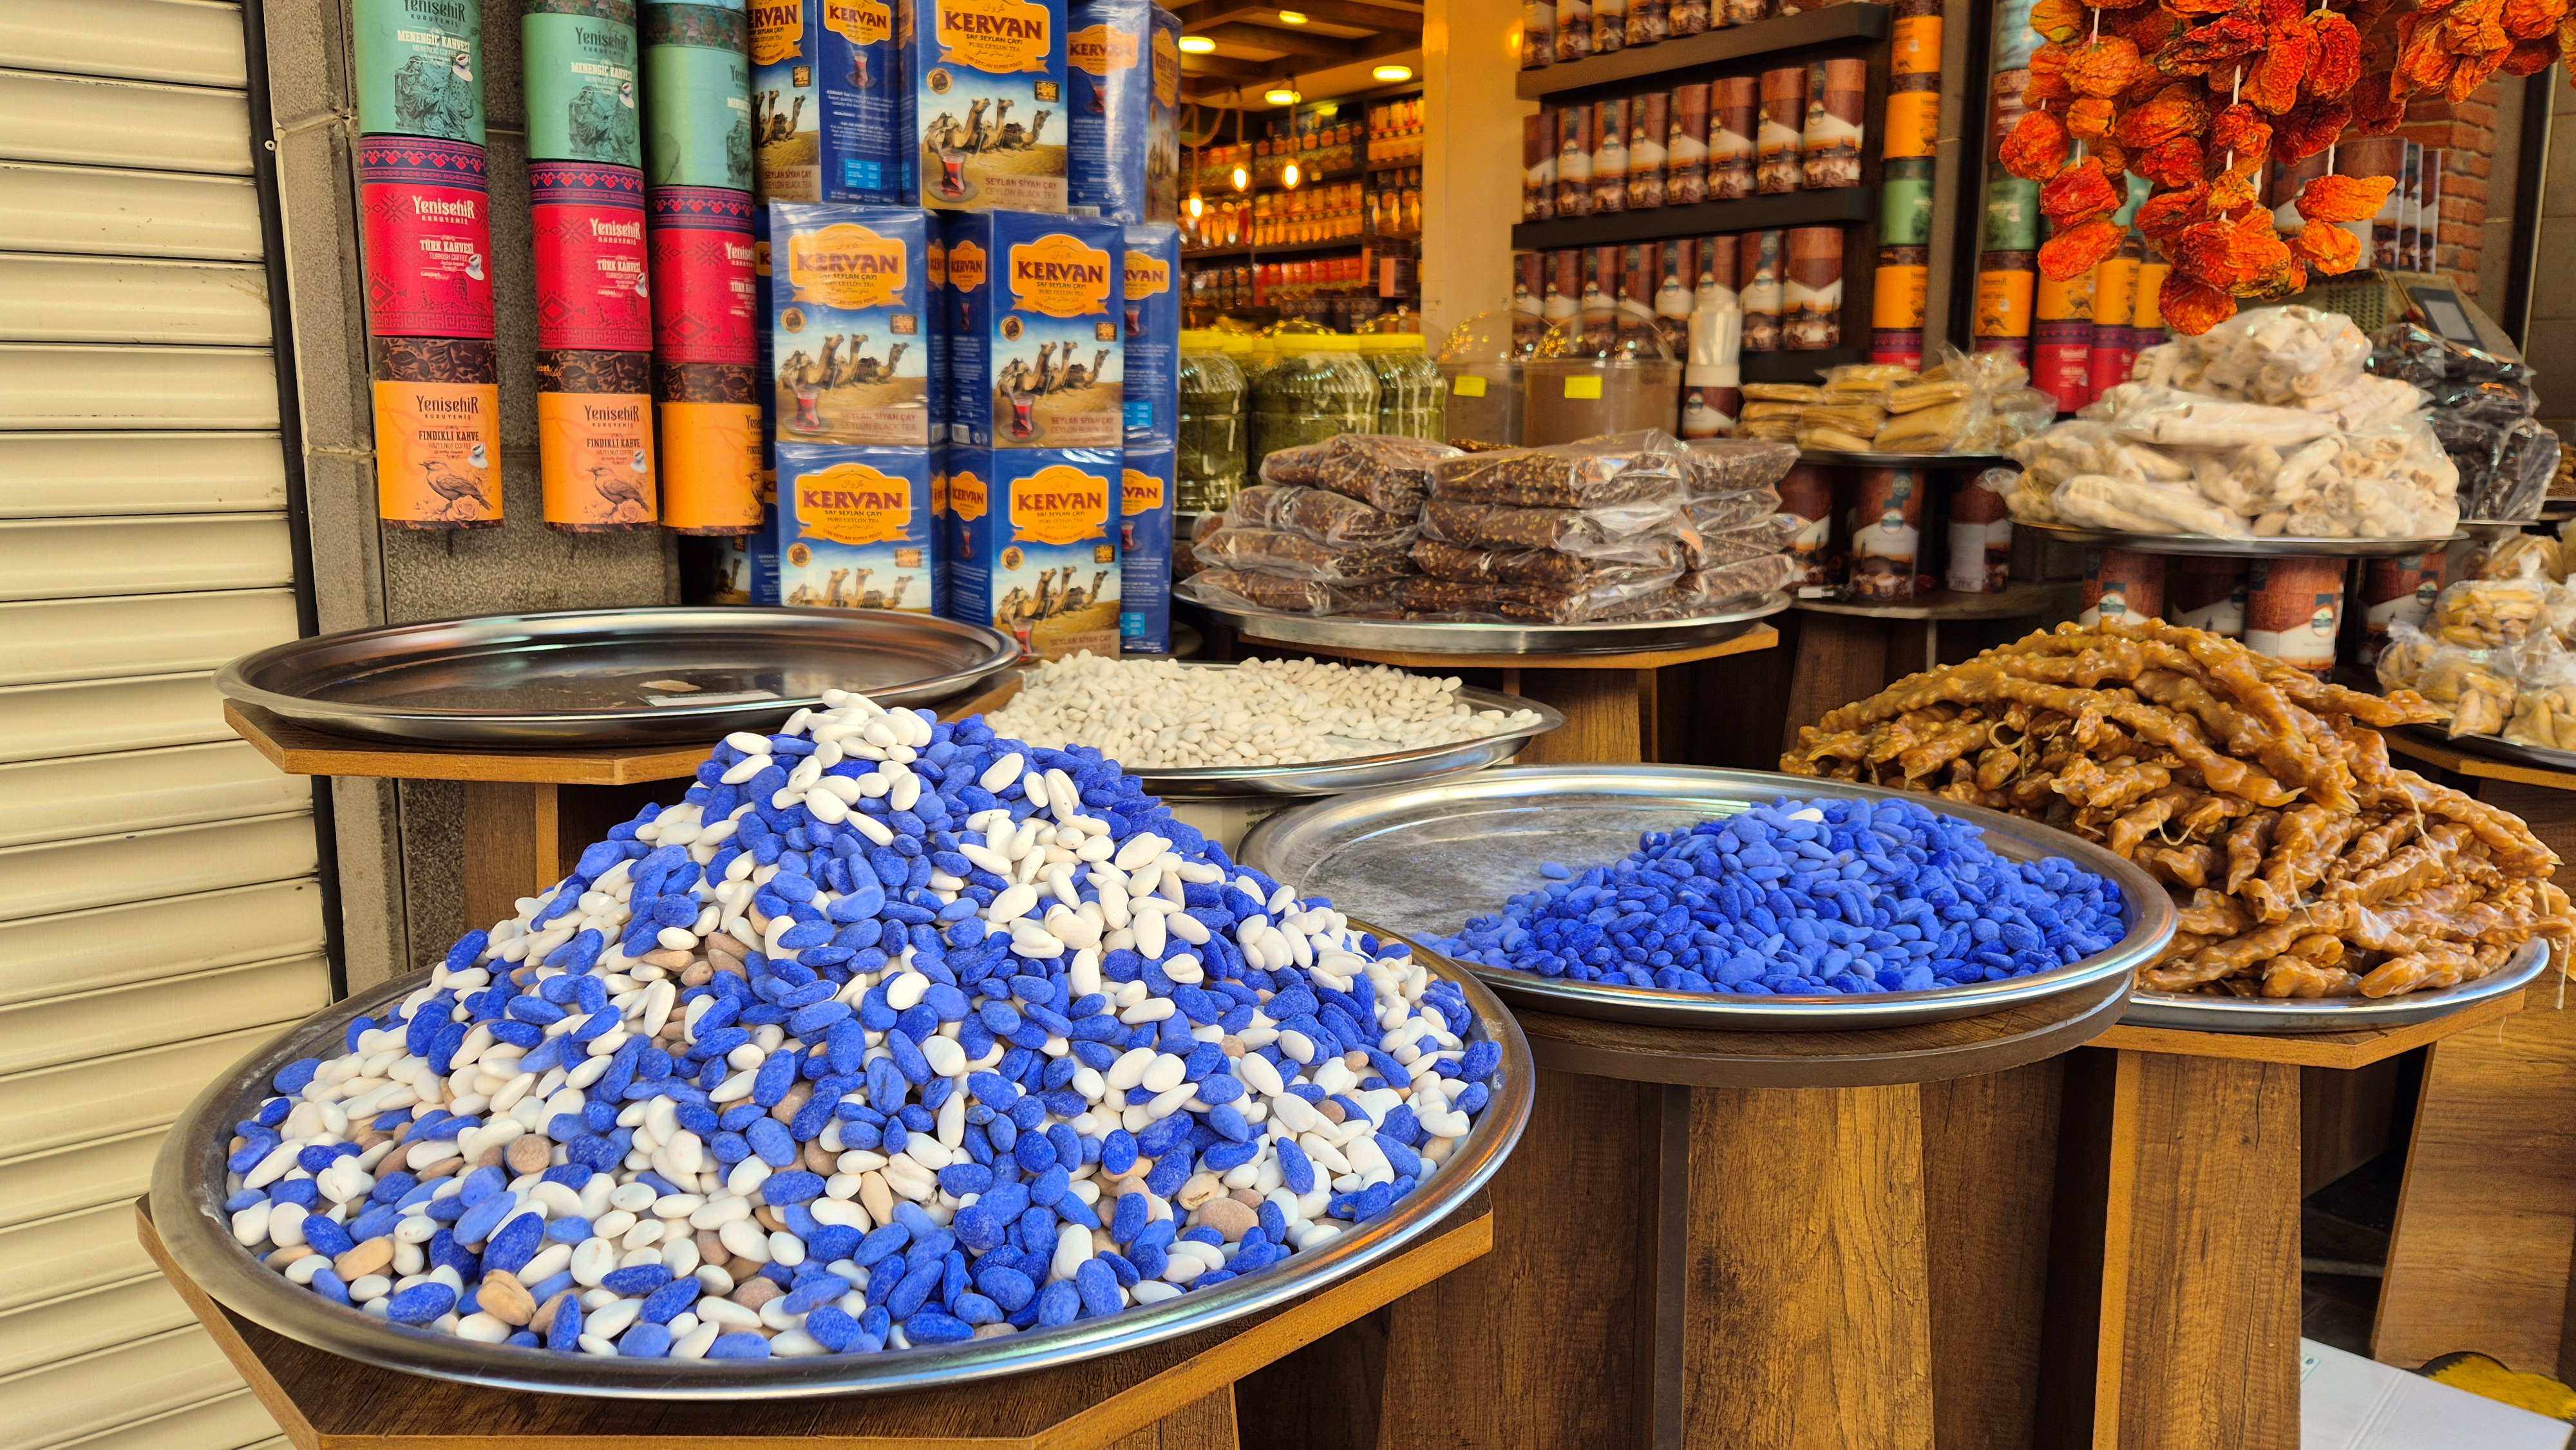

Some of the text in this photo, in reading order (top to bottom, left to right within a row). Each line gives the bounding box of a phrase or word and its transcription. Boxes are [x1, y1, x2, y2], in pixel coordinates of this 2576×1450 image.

[746, 5, 797, 28] ERVAN
[829, 6, 887, 29] KERVAN
[943, 10, 1043, 41] KERVAN
[980, 34, 1006, 43] SEYLAN
[985, 177, 1016, 186] SEYLAN
[419, 239, 442, 252] TÜRK
[596, 259, 616, 271] TÜRK
[797, 252, 898, 274] KERVAN
[951, 260, 983, 273] KERVAN
[1018, 261, 1104, 283] KERVAN
[419, 431, 479, 441] FINDIKLI KAHVE
[587, 438, 640, 448] FINDIKLI KAHVE
[803, 490, 903, 509] KERVAN
[952, 488, 984, 505] KERVAN
[1018, 492, 1102, 511] KERVAN
